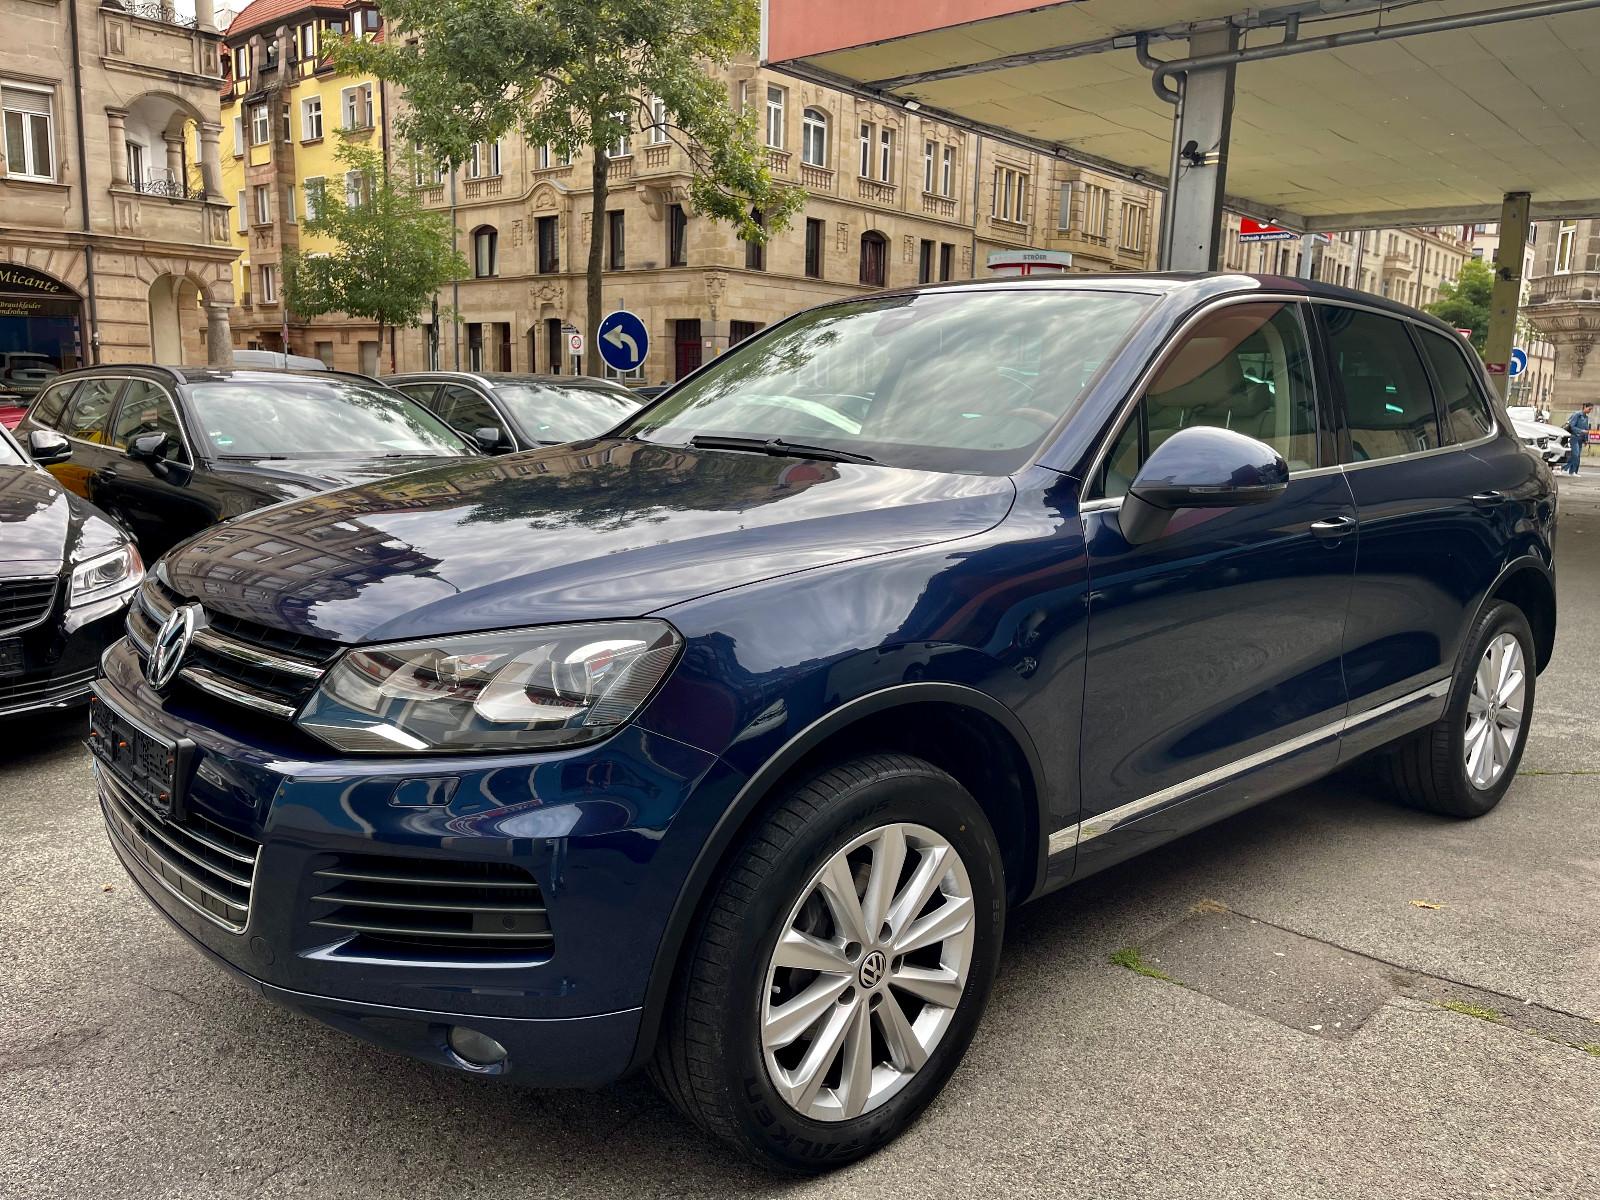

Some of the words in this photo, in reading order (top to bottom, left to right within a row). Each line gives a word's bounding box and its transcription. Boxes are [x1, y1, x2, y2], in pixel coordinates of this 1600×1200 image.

[1023, 253, 1047, 261] STRÖER
[0, 270, 60, 293] Micante
[859, 950, 887, 988] VW
